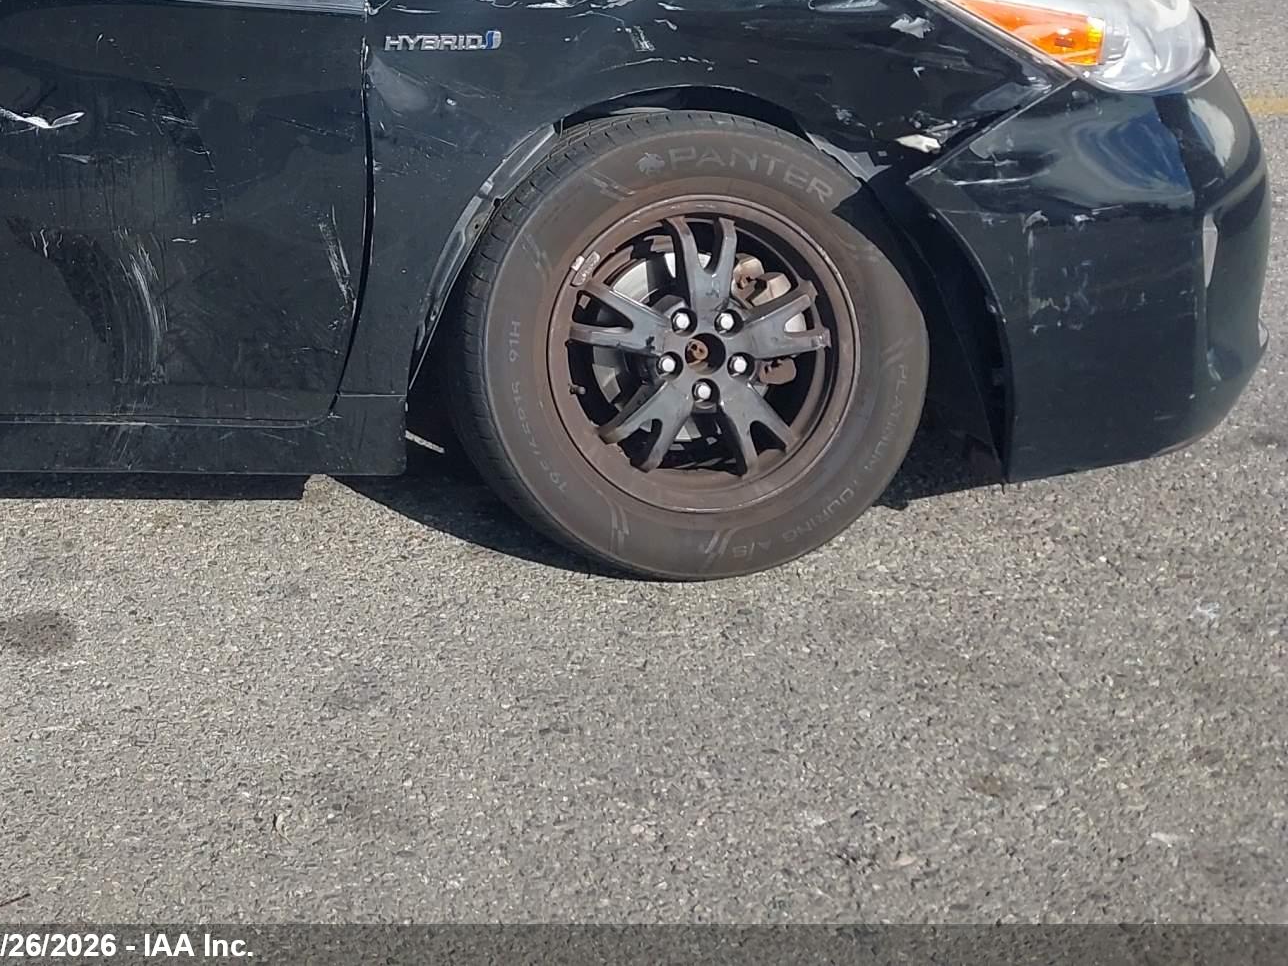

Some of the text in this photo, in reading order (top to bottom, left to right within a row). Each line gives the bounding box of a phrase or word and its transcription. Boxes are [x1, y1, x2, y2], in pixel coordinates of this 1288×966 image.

[384, 34, 484, 51] HYBRID
[667, 147, 834, 203] PANTER
[508, 320, 521, 362] 91H
